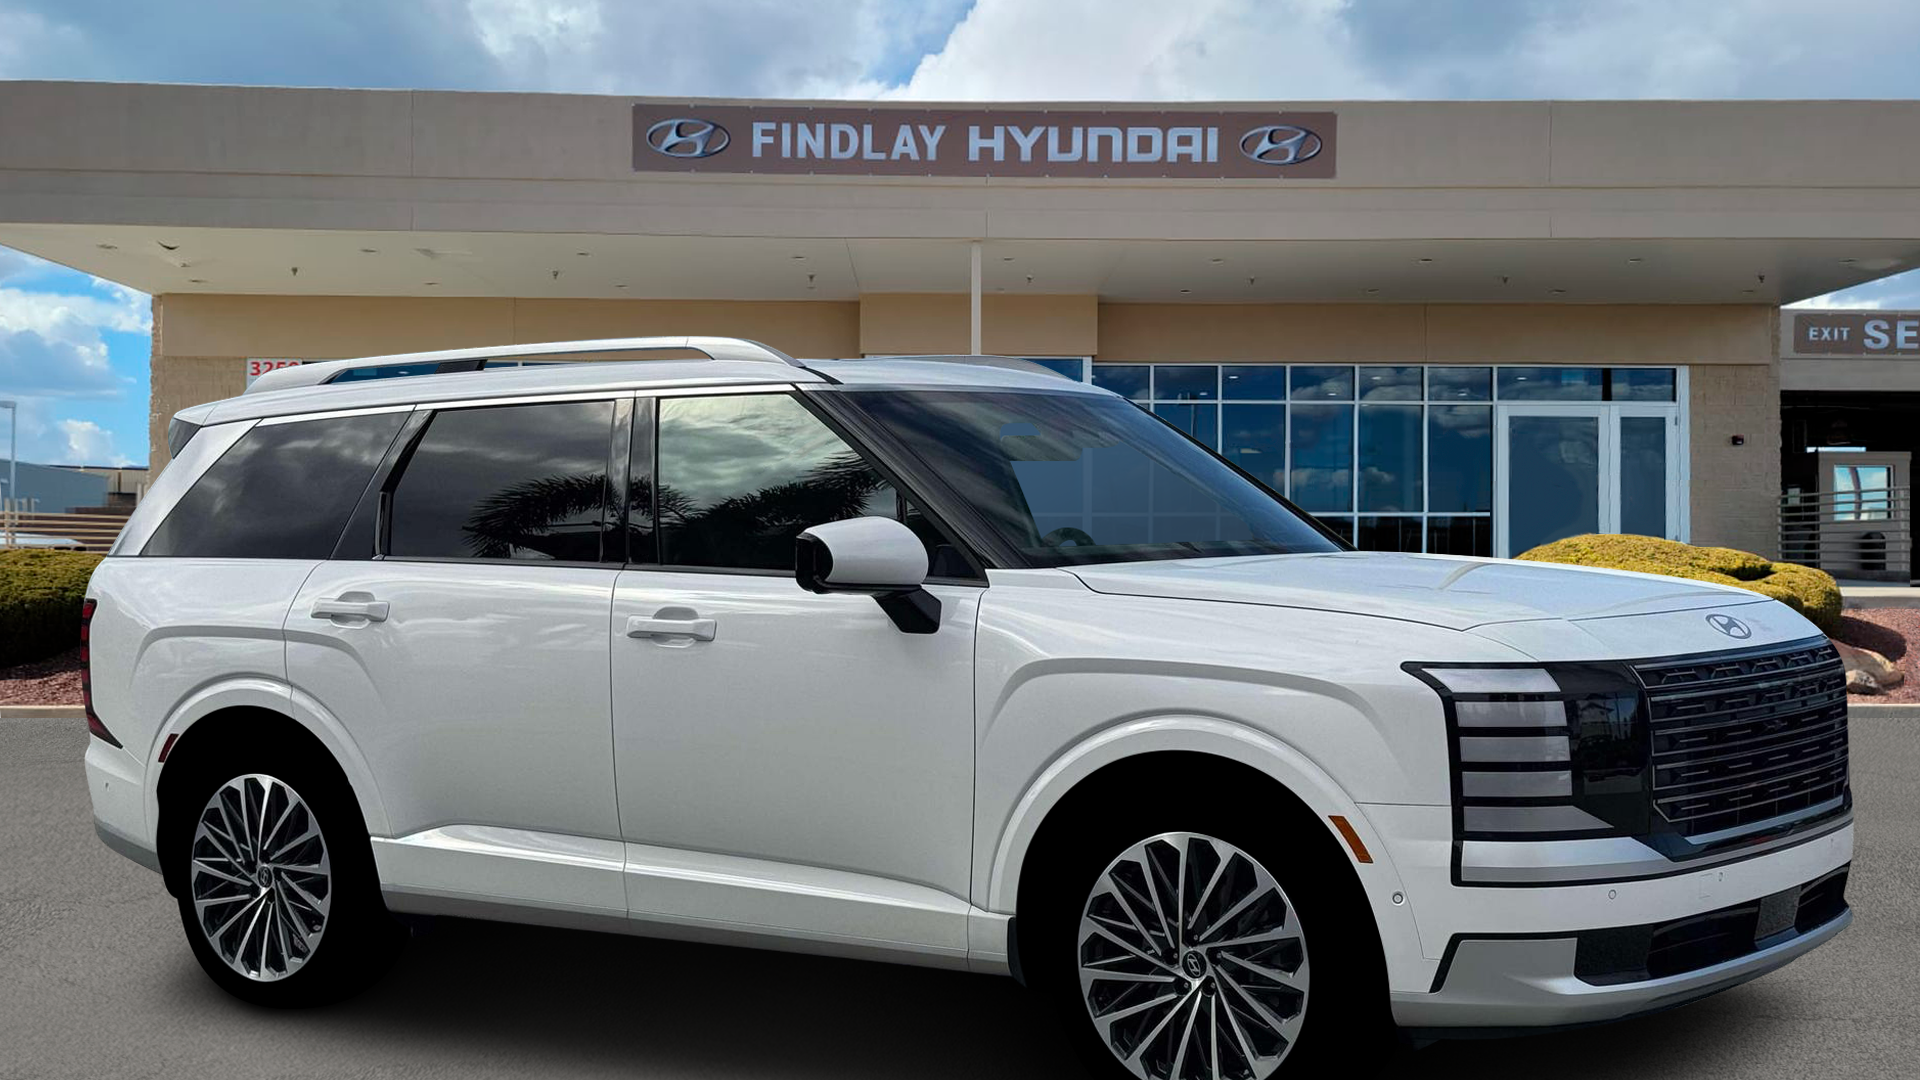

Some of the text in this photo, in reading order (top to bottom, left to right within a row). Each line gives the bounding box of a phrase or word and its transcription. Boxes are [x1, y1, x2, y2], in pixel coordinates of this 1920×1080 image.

[752, 122, 1219, 162] FINDLAY HYUNDAI
[1808, 319, 1919, 349] EXIT SE
